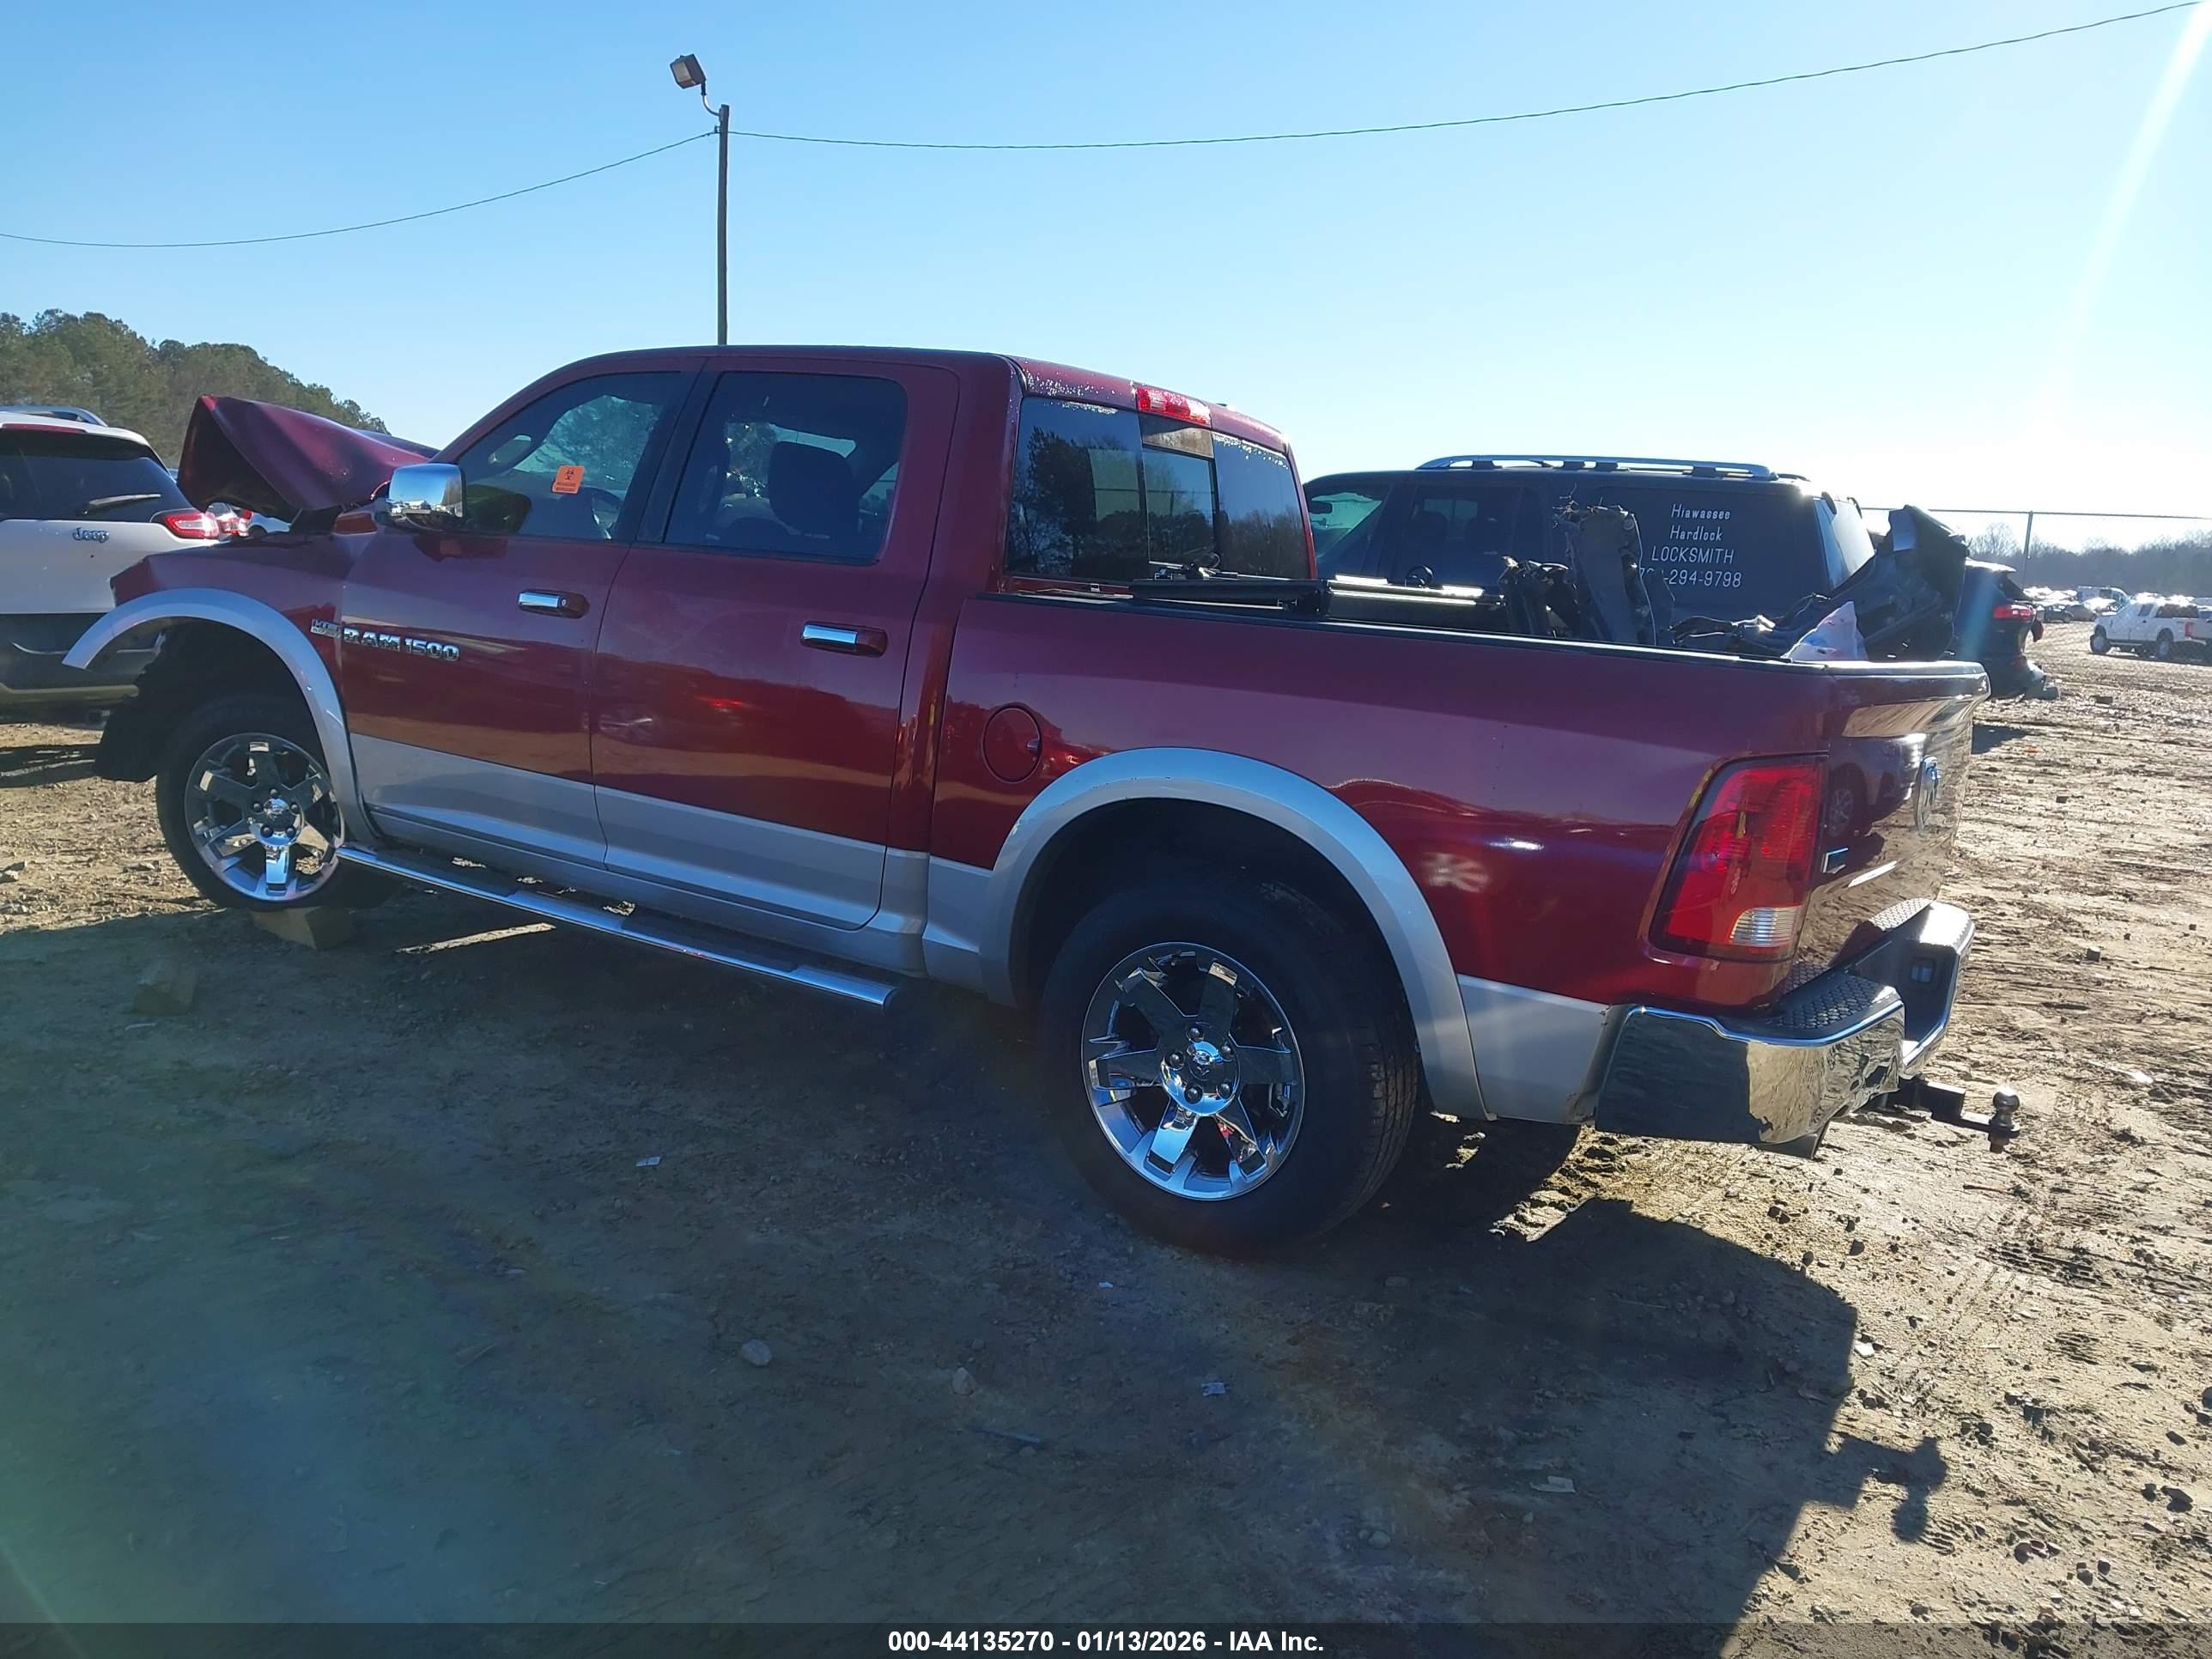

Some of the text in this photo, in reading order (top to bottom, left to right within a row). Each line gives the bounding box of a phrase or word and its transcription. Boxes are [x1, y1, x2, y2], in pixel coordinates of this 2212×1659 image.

[1671, 503, 1731, 520] Hiawassee
[72, 527, 110, 543] Jeep
[1669, 525, 1723, 541] Hardlock
[1651, 546, 1735, 564] LOCKSMITH
[1639, 567, 1742, 587] 7-294-9798
[343, 628, 401, 652] RAM
[404, 638, 460, 661] 1500
